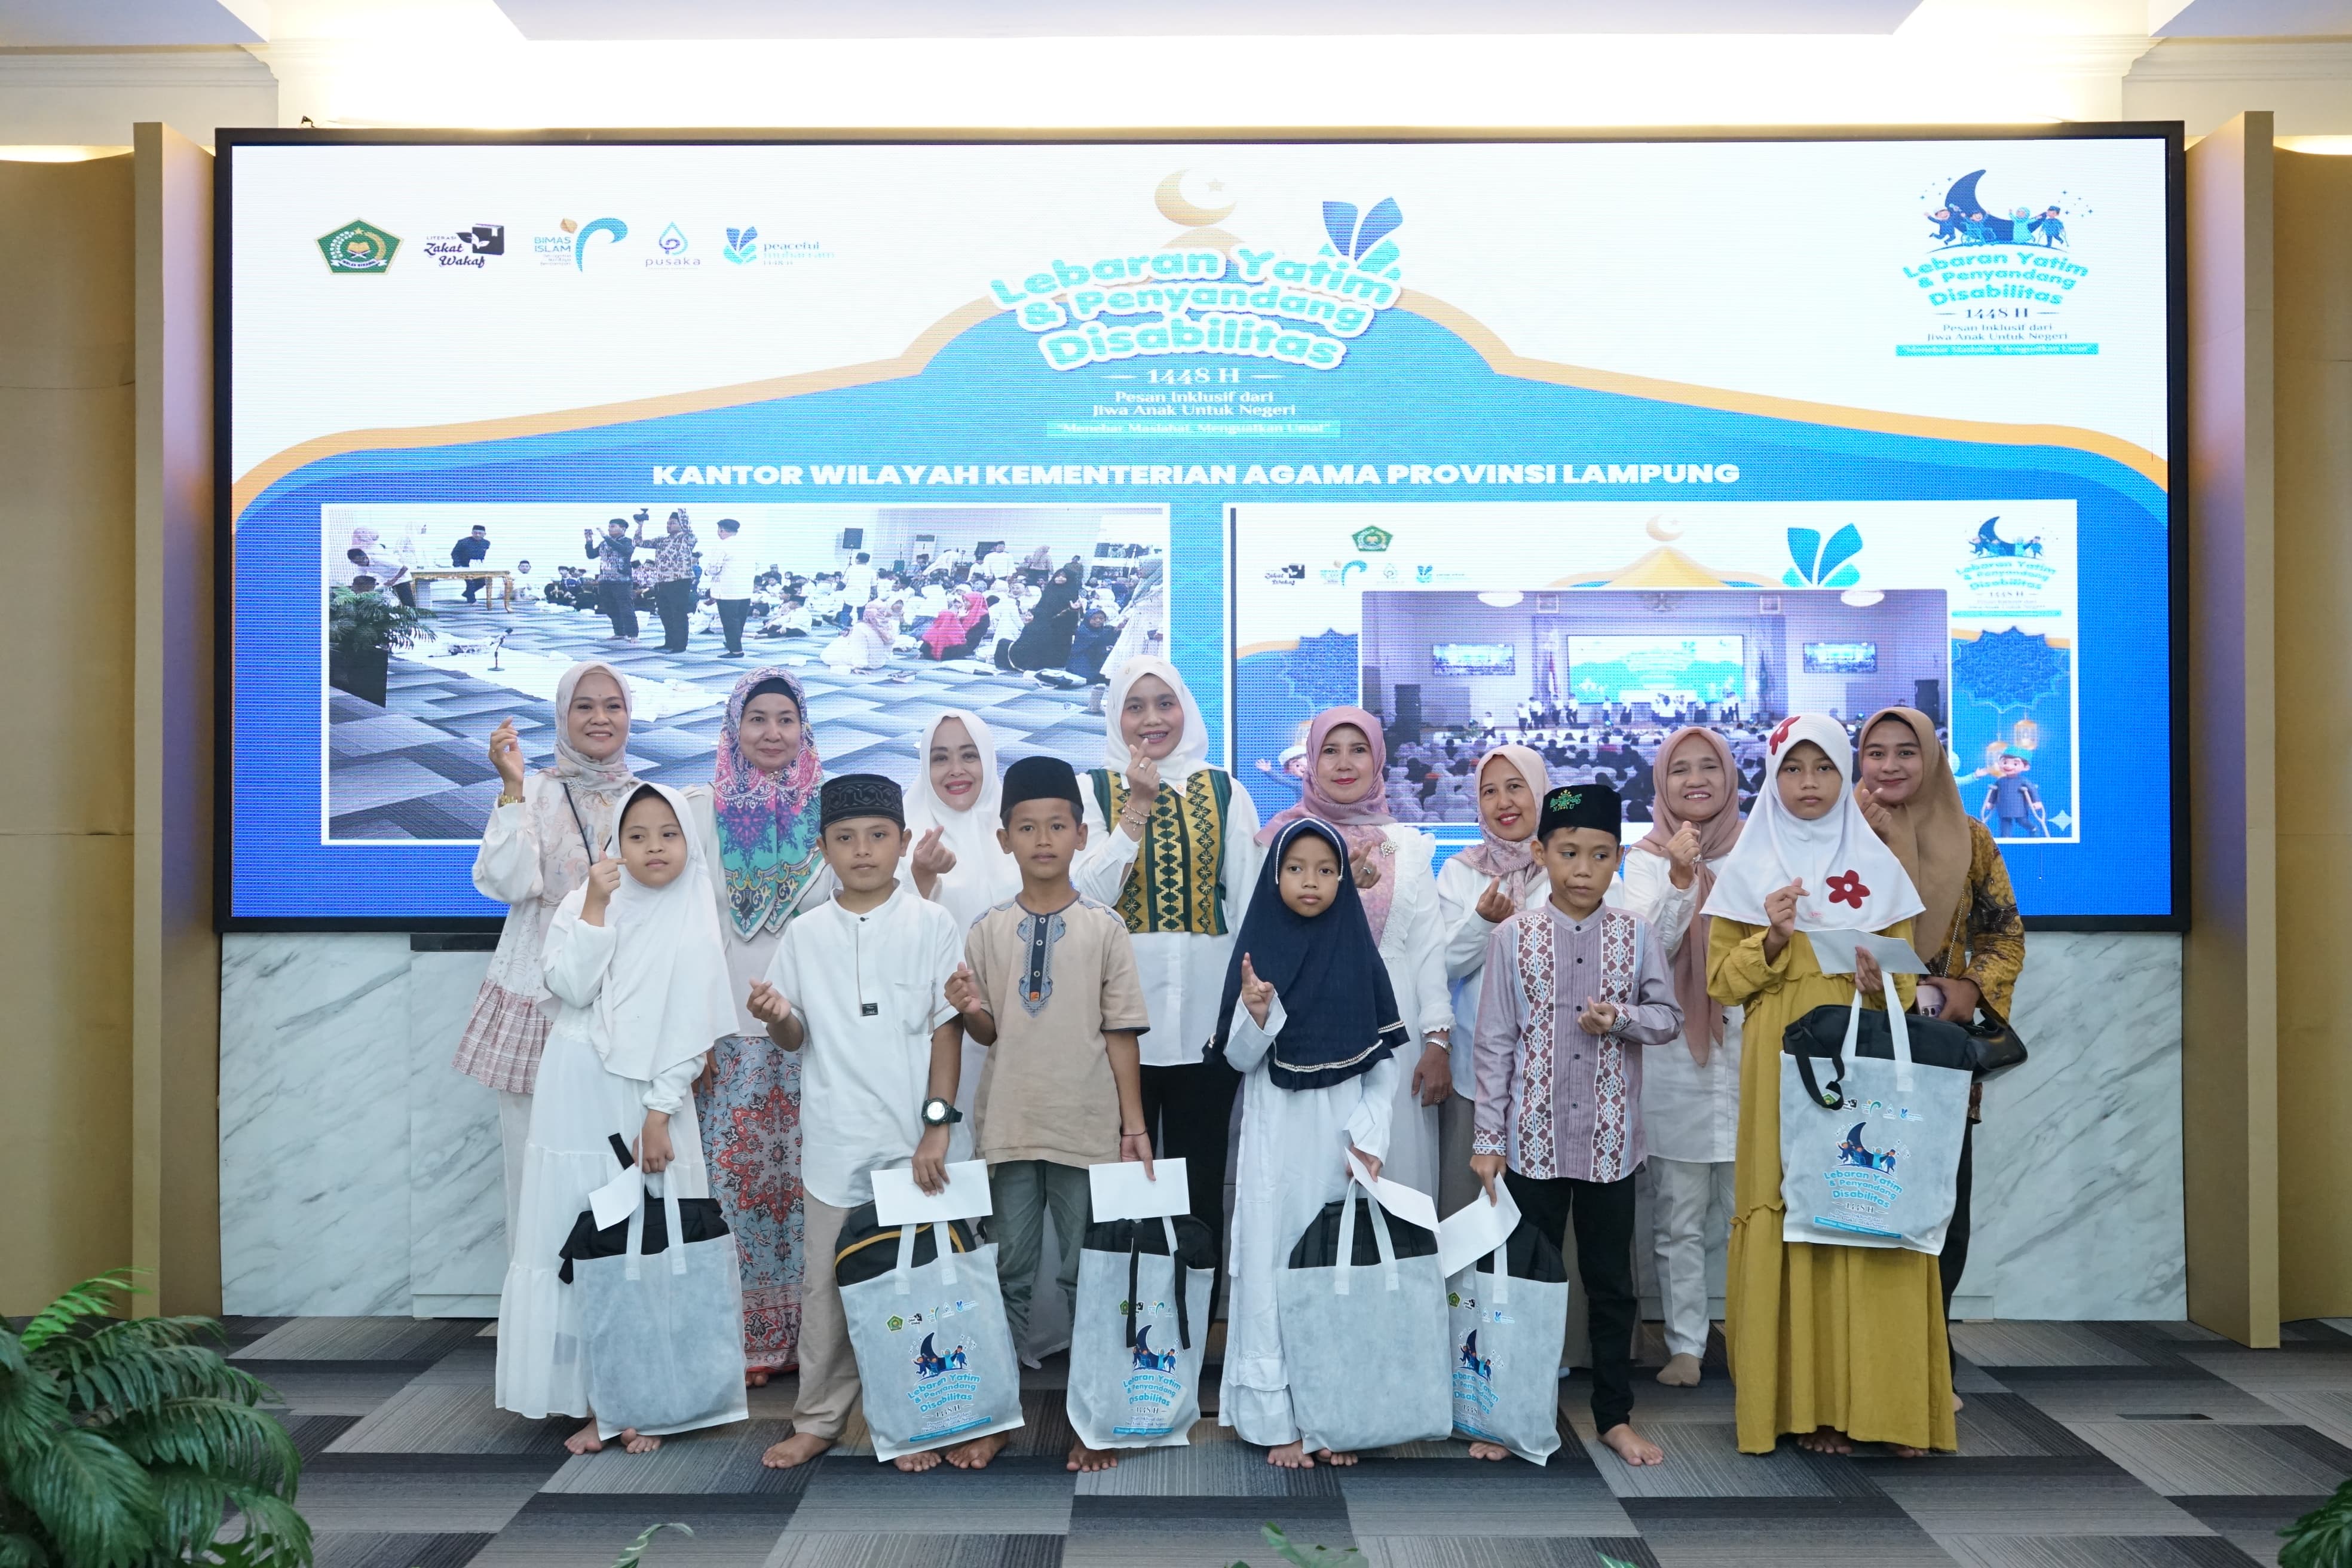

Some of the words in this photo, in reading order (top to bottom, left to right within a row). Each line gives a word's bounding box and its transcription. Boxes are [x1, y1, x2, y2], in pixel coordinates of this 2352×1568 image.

[424, 243, 464, 256] Zakat
[439, 255, 485, 268] Wakaf
[645, 258, 700, 267] pusaka
[1902, 251, 2008, 279] Lebaran
[2017, 251, 2089, 277] Yatim
[990, 253, 1219, 305] Lebaran
[1237, 248, 1394, 305] Yatim
[1918, 277, 1934, 289] &
[1941, 268, 2077, 291] Penyandang
[1928, 284, 2063, 307] Disabilitas
[1024, 302, 1059, 325] &
[1074, 285, 1367, 332] Penyandang
[1965, 308, 2008, 319] 1448
[1046, 317, 1338, 365] Disabilitas
[2029, 332, 2068, 341] Negeri
[1147, 367, 1211, 385] 1448
[1218, 368, 1239, 384] H
[1115, 391, 1165, 402] Pesan
[1171, 391, 1233, 402] Inklusif
[1239, 391, 1273, 402] dari
[1092, 404, 1128, 418] Jiwa
[1133, 404, 1177, 416] Anak
[1182, 404, 1233, 416] Untuk
[1239, 404, 1296, 418] Negeri
[654, 465, 804, 485] KANTOR
[810, 465, 985, 485] WILAYAH
[988, 465, 1236, 485] KEMENTERIAN
[1242, 464, 1383, 485] AGAMA
[1388, 464, 1555, 485] PROVINSI
[1563, 464, 1740, 484] LAMPUNG
[1824, 1169, 1869, 1180] Lebaran
[1873, 1174, 1903, 1193] Yatim
[1839, 1179, 1897, 1200] Penyandang
[1832, 1189, 1890, 1208] Disabilitas
[907, 1376, 947, 1399] Lebaran
[949, 1373, 981, 1383] Yatim
[923, 1382, 976, 1399] Penyandang
[1158, 1374, 1181, 1391] Yatim
[1479, 1380, 1499, 1402] Yatim
[920, 1392, 973, 1413] Disabilitas
